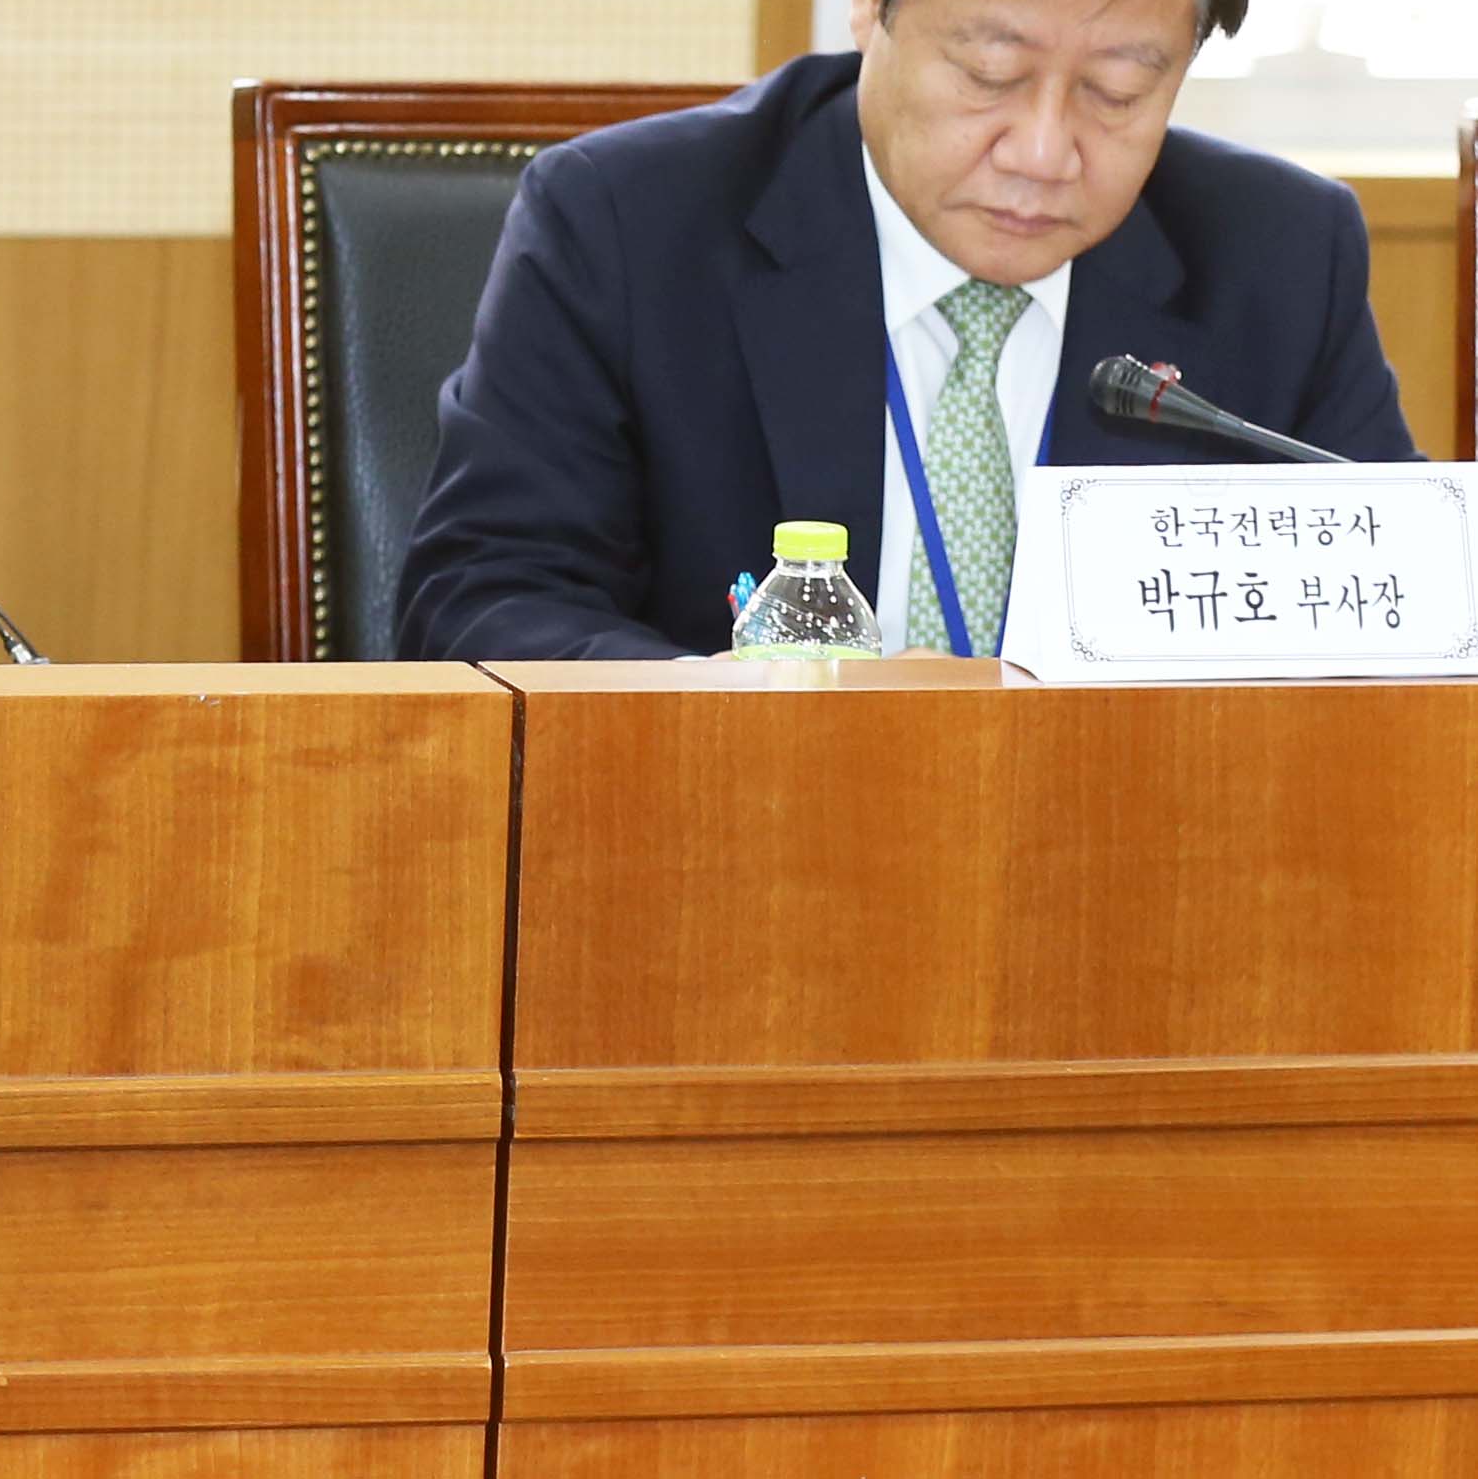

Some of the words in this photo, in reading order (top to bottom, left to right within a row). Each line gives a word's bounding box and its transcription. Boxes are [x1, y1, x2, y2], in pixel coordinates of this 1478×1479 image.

[1150, 505, 1381, 548] 한국전력공사
[1138, 568, 1277, 633] 박규호
[1296, 573, 1405, 630] 부사장
